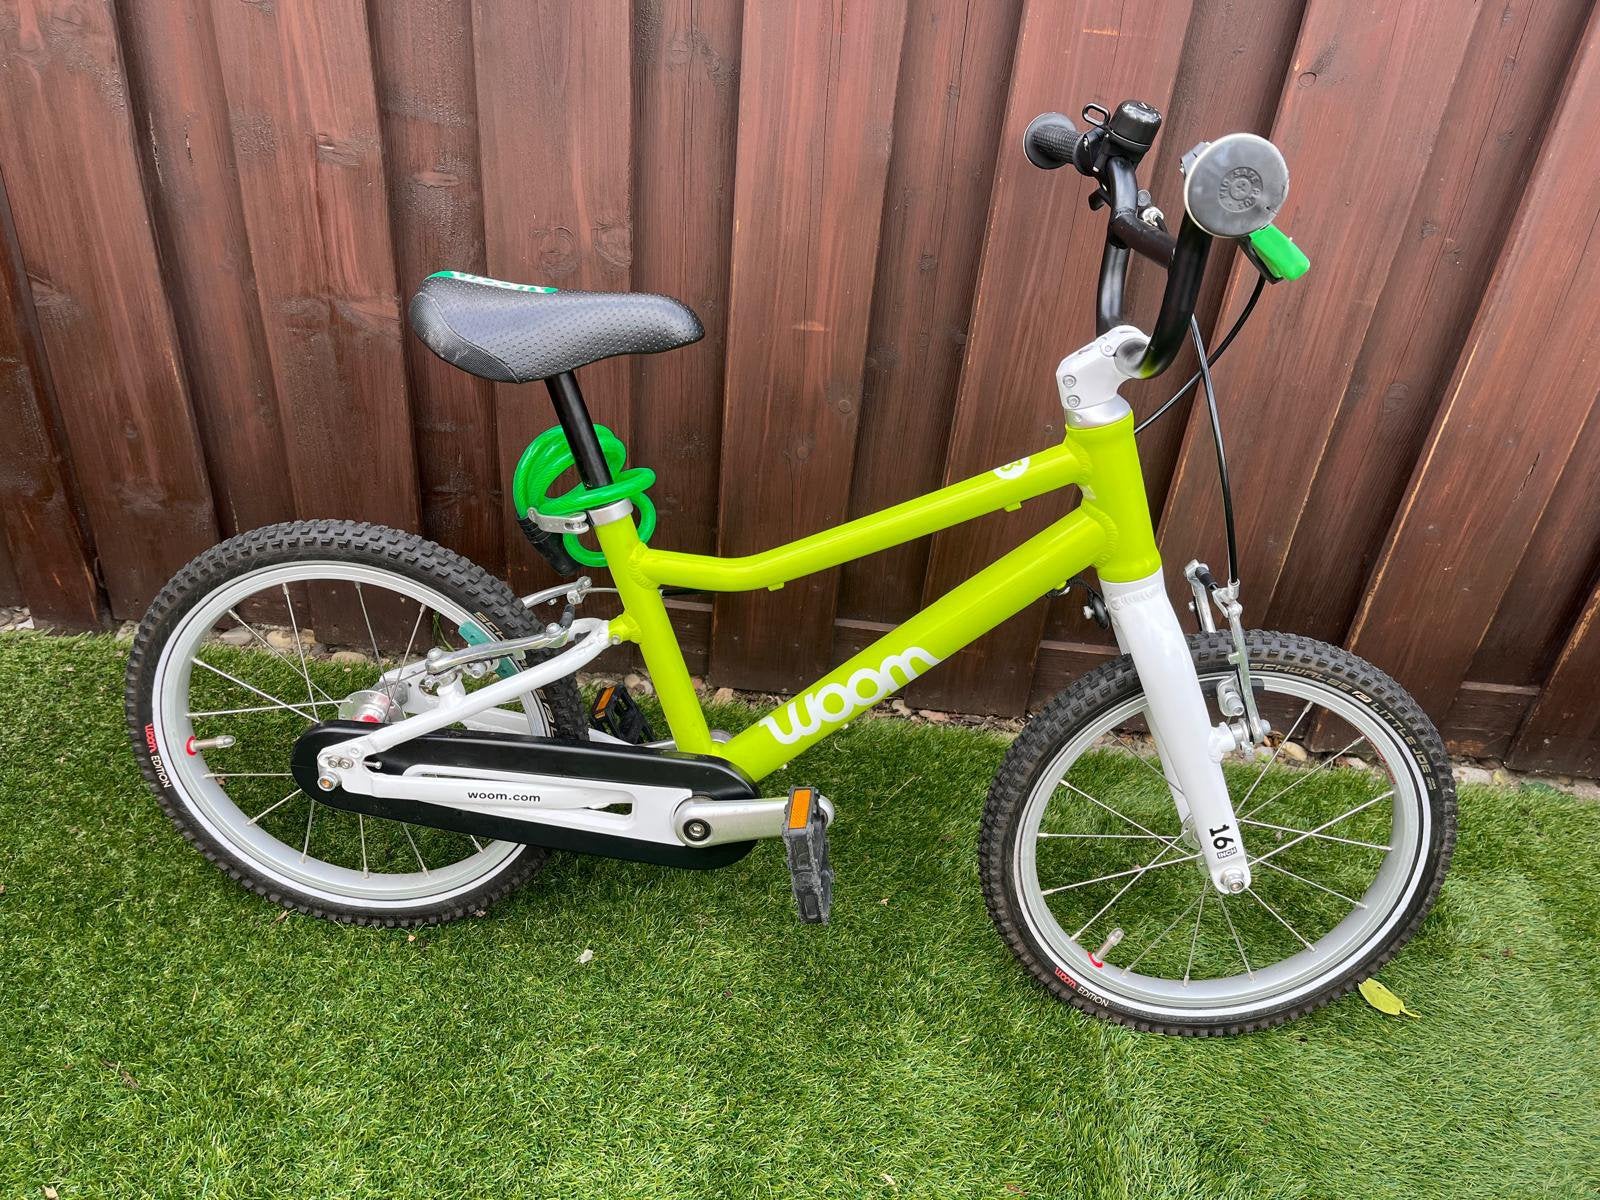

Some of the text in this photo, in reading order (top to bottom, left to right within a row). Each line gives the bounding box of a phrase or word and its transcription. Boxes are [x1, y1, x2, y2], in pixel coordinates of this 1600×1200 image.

[758, 646, 942, 744] woom
[1249, 663, 1353, 692] SCHWALBE
[1371, 703, 1416, 746] LITTLE
[1412, 747, 1432, 774] JOE
[151, 755, 172, 788] EDITION
[467, 791, 541, 802] woom.com
[1209, 824, 1234, 850] 16
[1217, 847, 1237, 859] INCH
[1077, 986, 1109, 1007] EDITION
